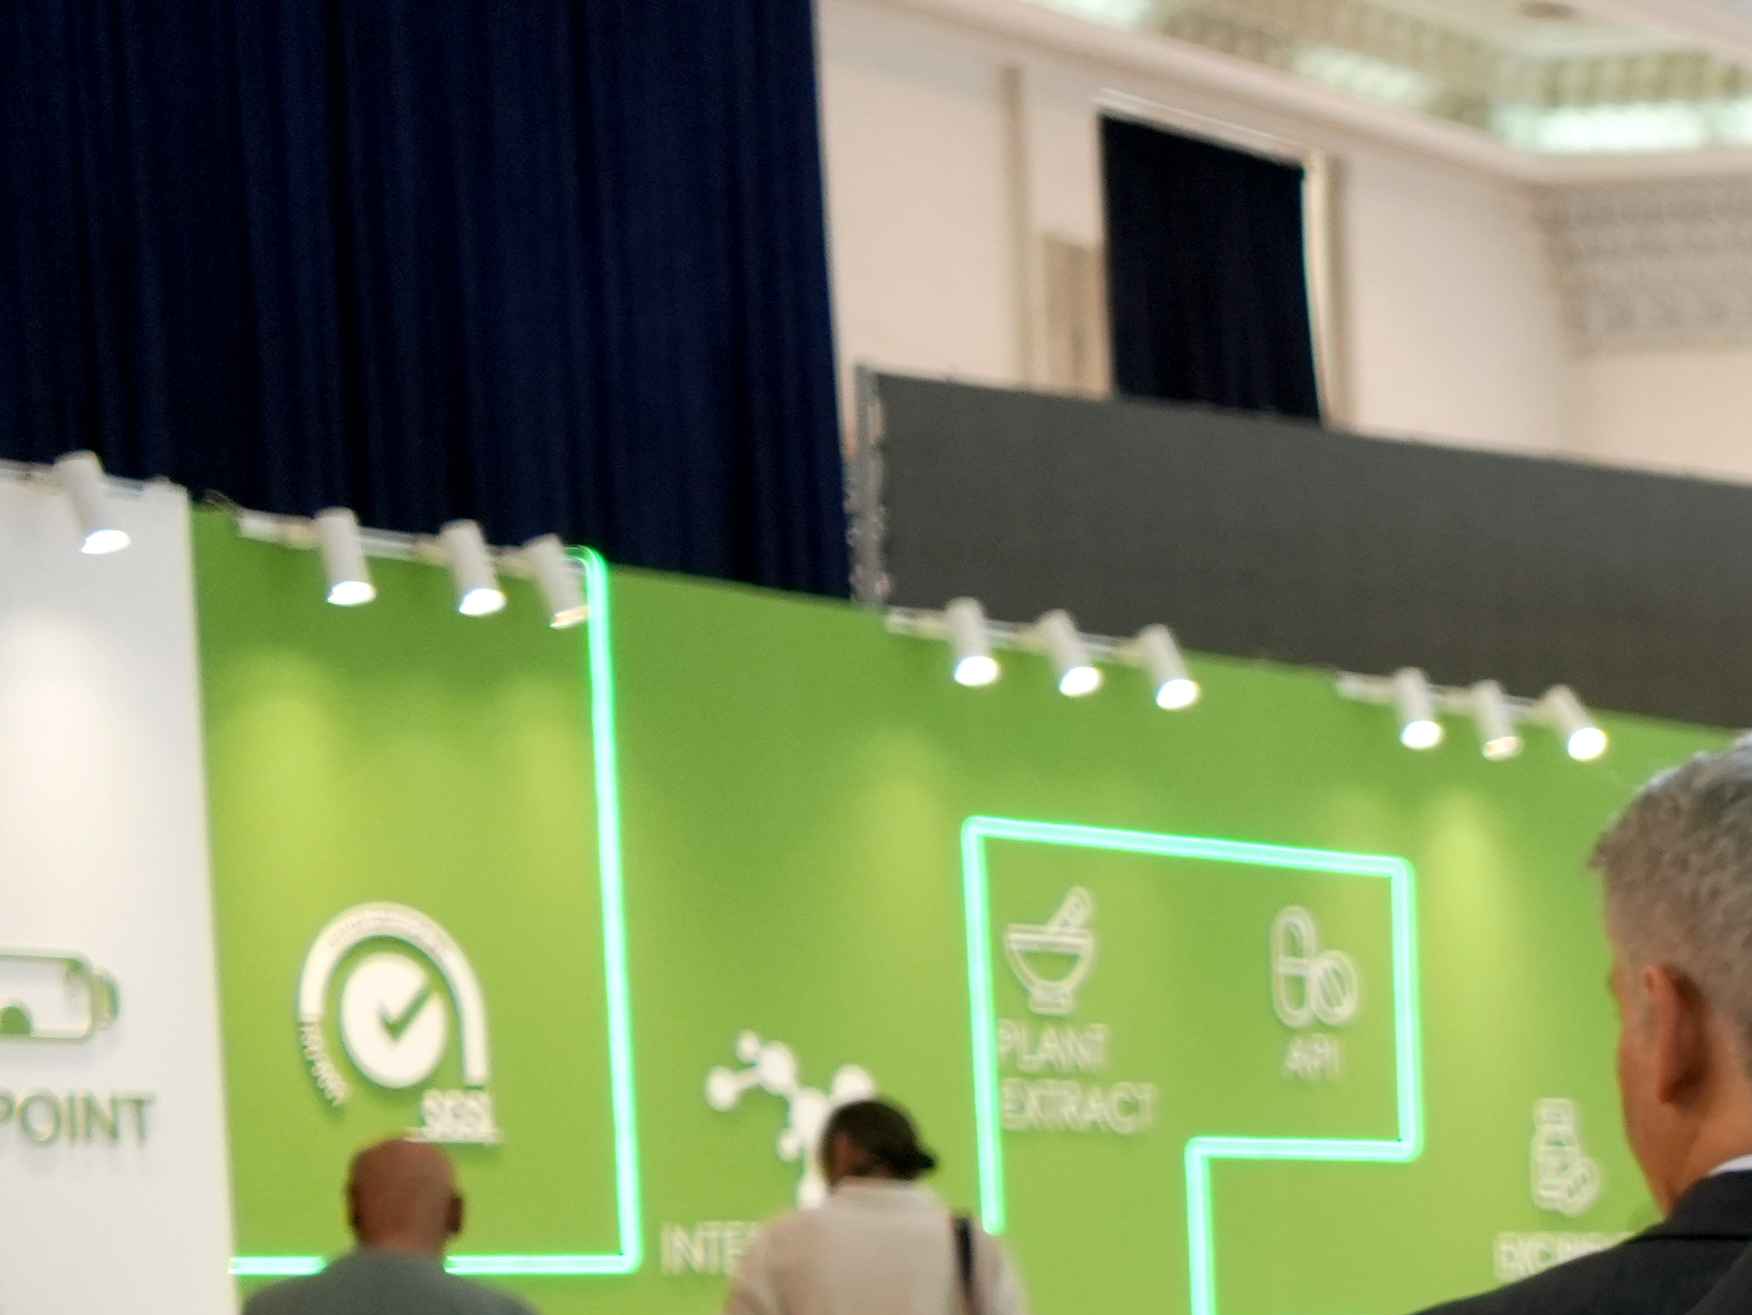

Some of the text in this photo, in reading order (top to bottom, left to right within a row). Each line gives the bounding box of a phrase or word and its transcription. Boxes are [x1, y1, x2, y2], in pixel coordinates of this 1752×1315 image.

[998, 1018, 1110, 1073] PLANT
[1283, 1033, 1342, 1080] API
[1002, 1077, 1159, 1134] EXTRACT
[661, 1219, 757, 1276] INTE
